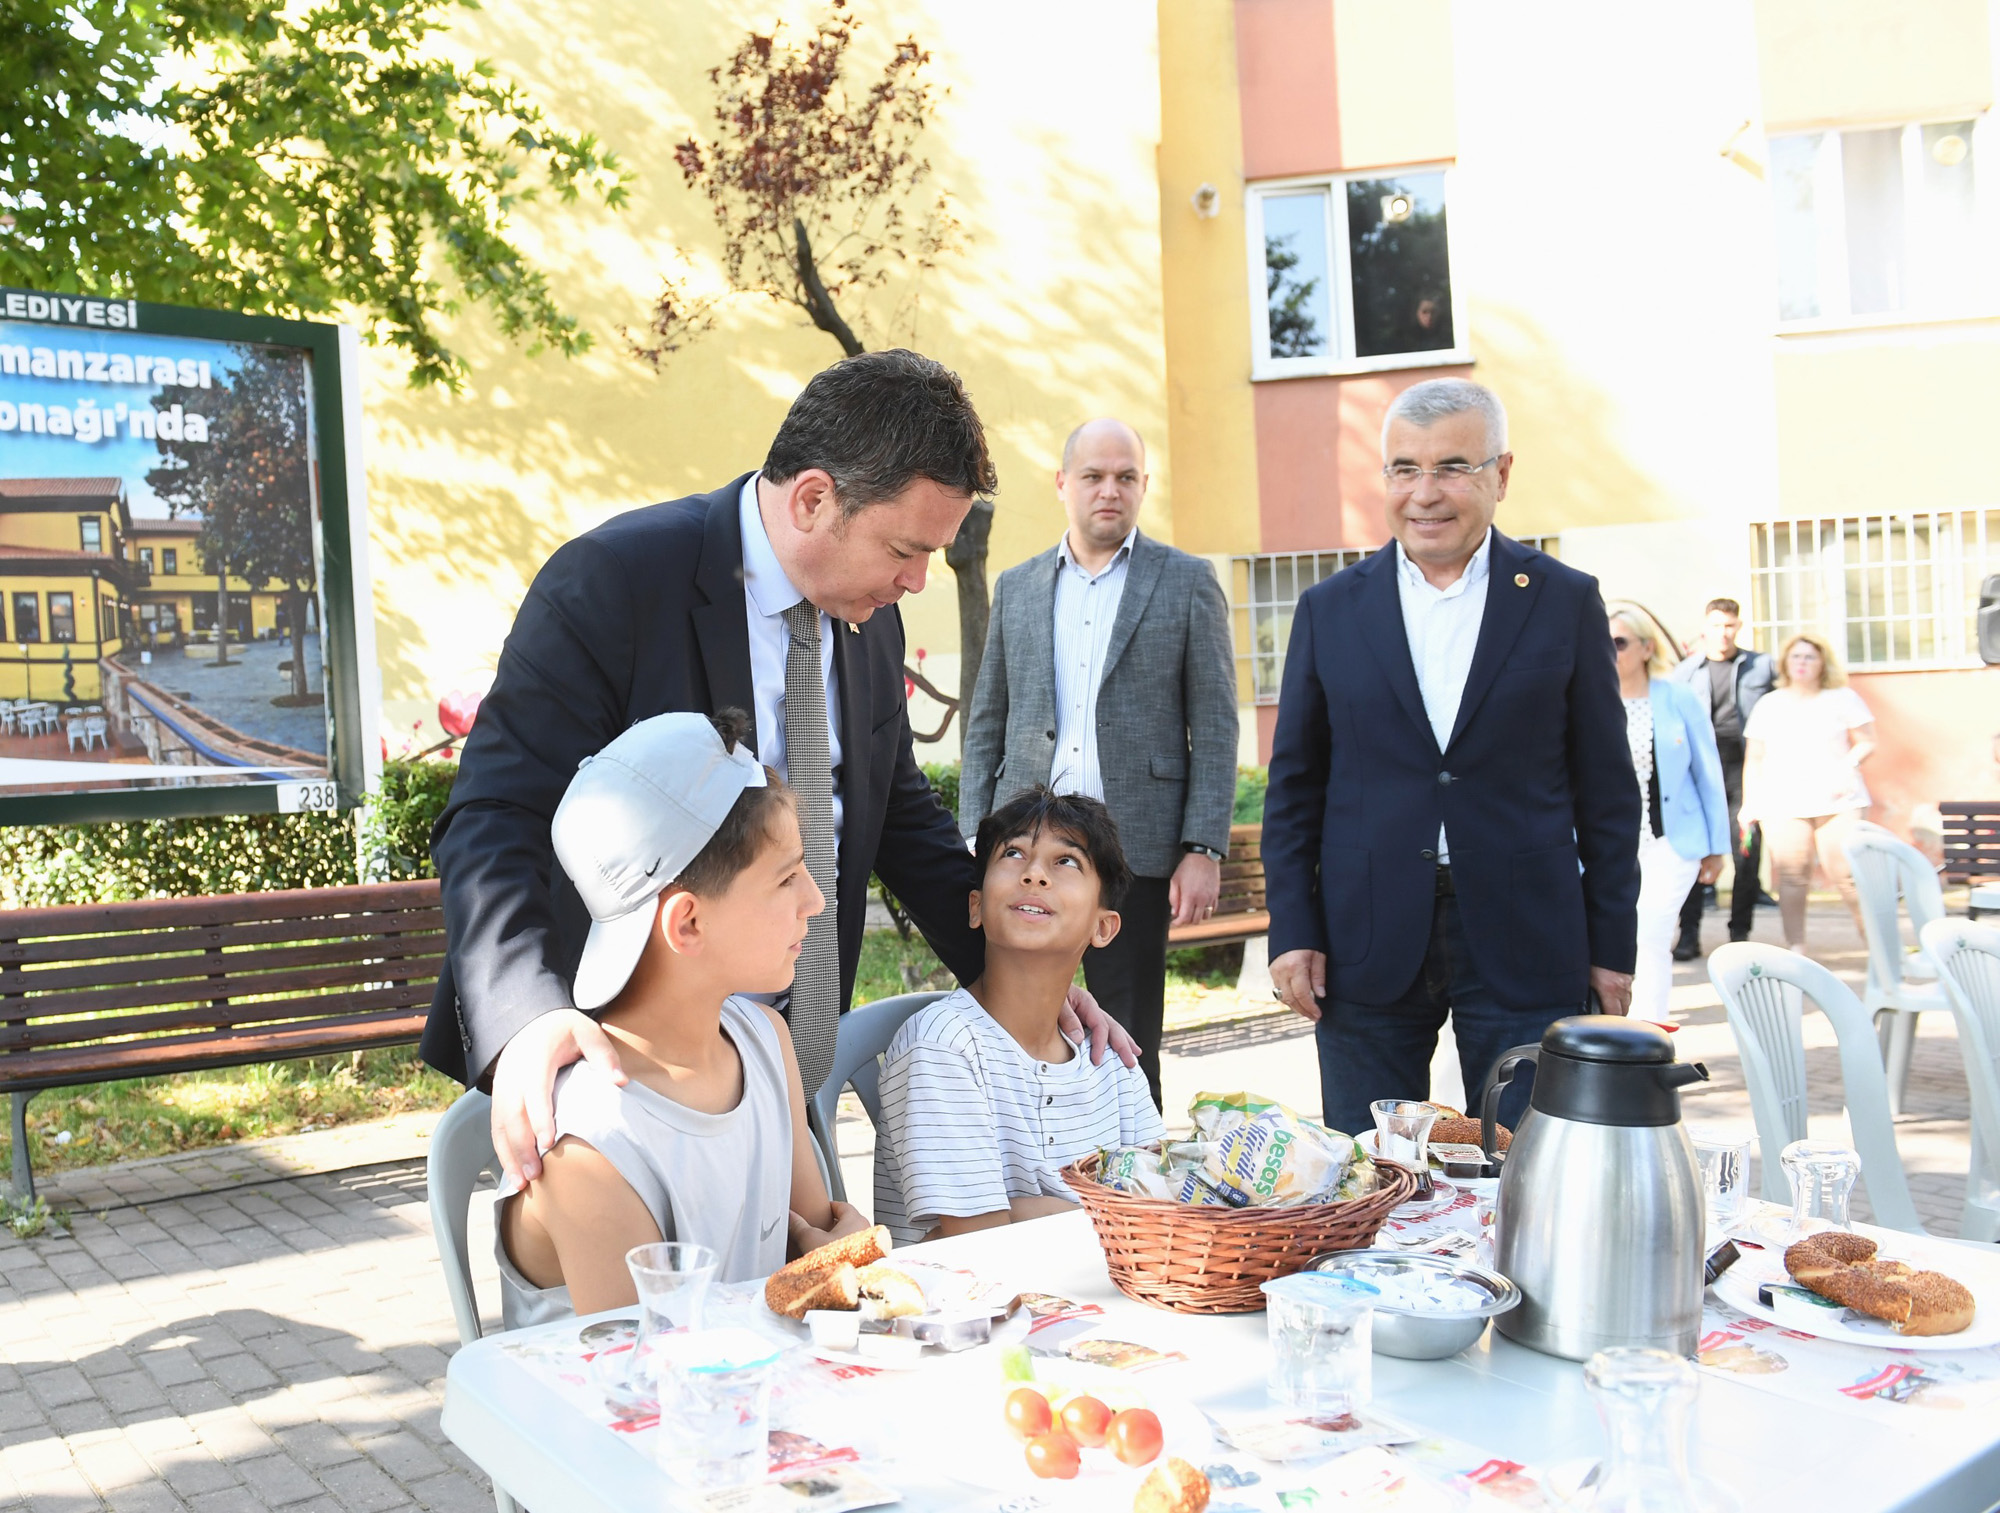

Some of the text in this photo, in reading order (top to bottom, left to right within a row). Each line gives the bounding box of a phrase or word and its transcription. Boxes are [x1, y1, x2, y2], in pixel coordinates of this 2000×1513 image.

[0, 293, 138, 329] EDIYESİ
[0, 343, 212, 389] manzarası
[300, 786, 335, 810] 238
[1255, 1129, 1297, 1197] besaş
